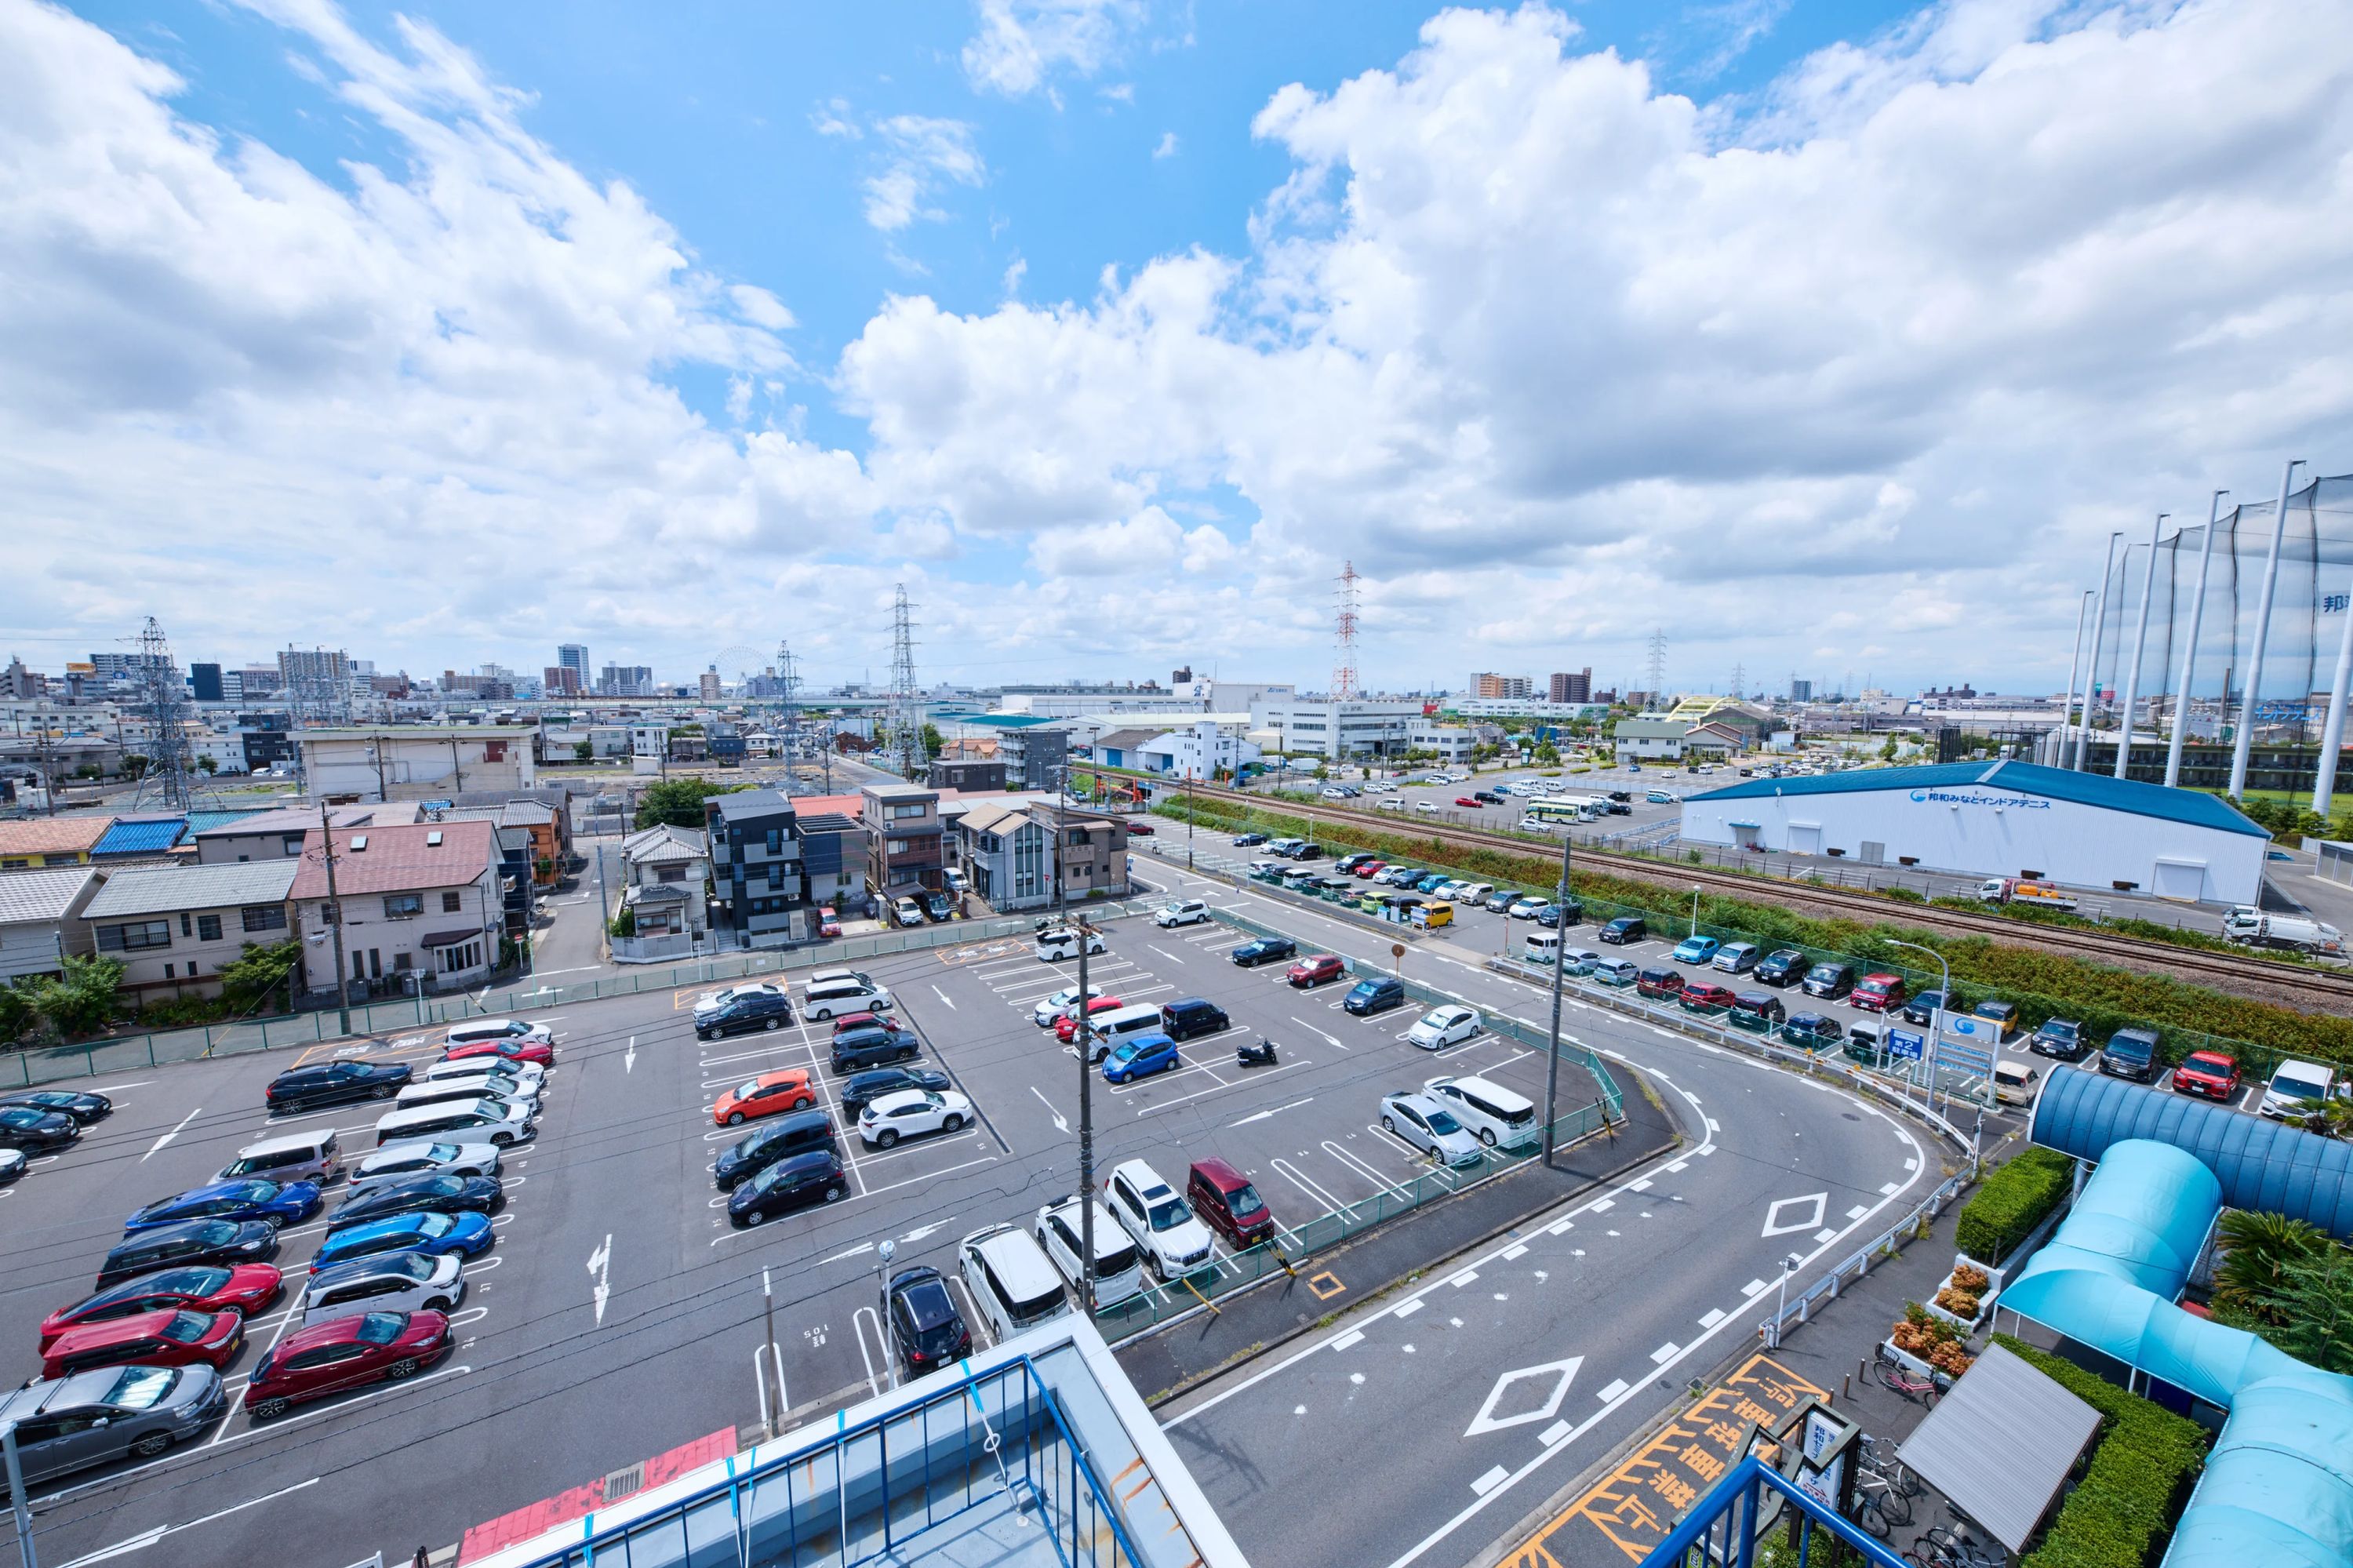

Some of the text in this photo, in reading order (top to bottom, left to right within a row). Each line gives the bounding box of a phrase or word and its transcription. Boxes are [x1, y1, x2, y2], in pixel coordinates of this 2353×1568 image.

[1928, 793, 2050, 809] 邦和みなとインドアテニス
[1895, 1039, 1914, 1051] 第2
[1892, 1046, 1918, 1058] 駐車場
[479, 1282, 493, 1293] 37
[804, 1323, 829, 1339] 105
[462, 1336, 476, 1349] 36
